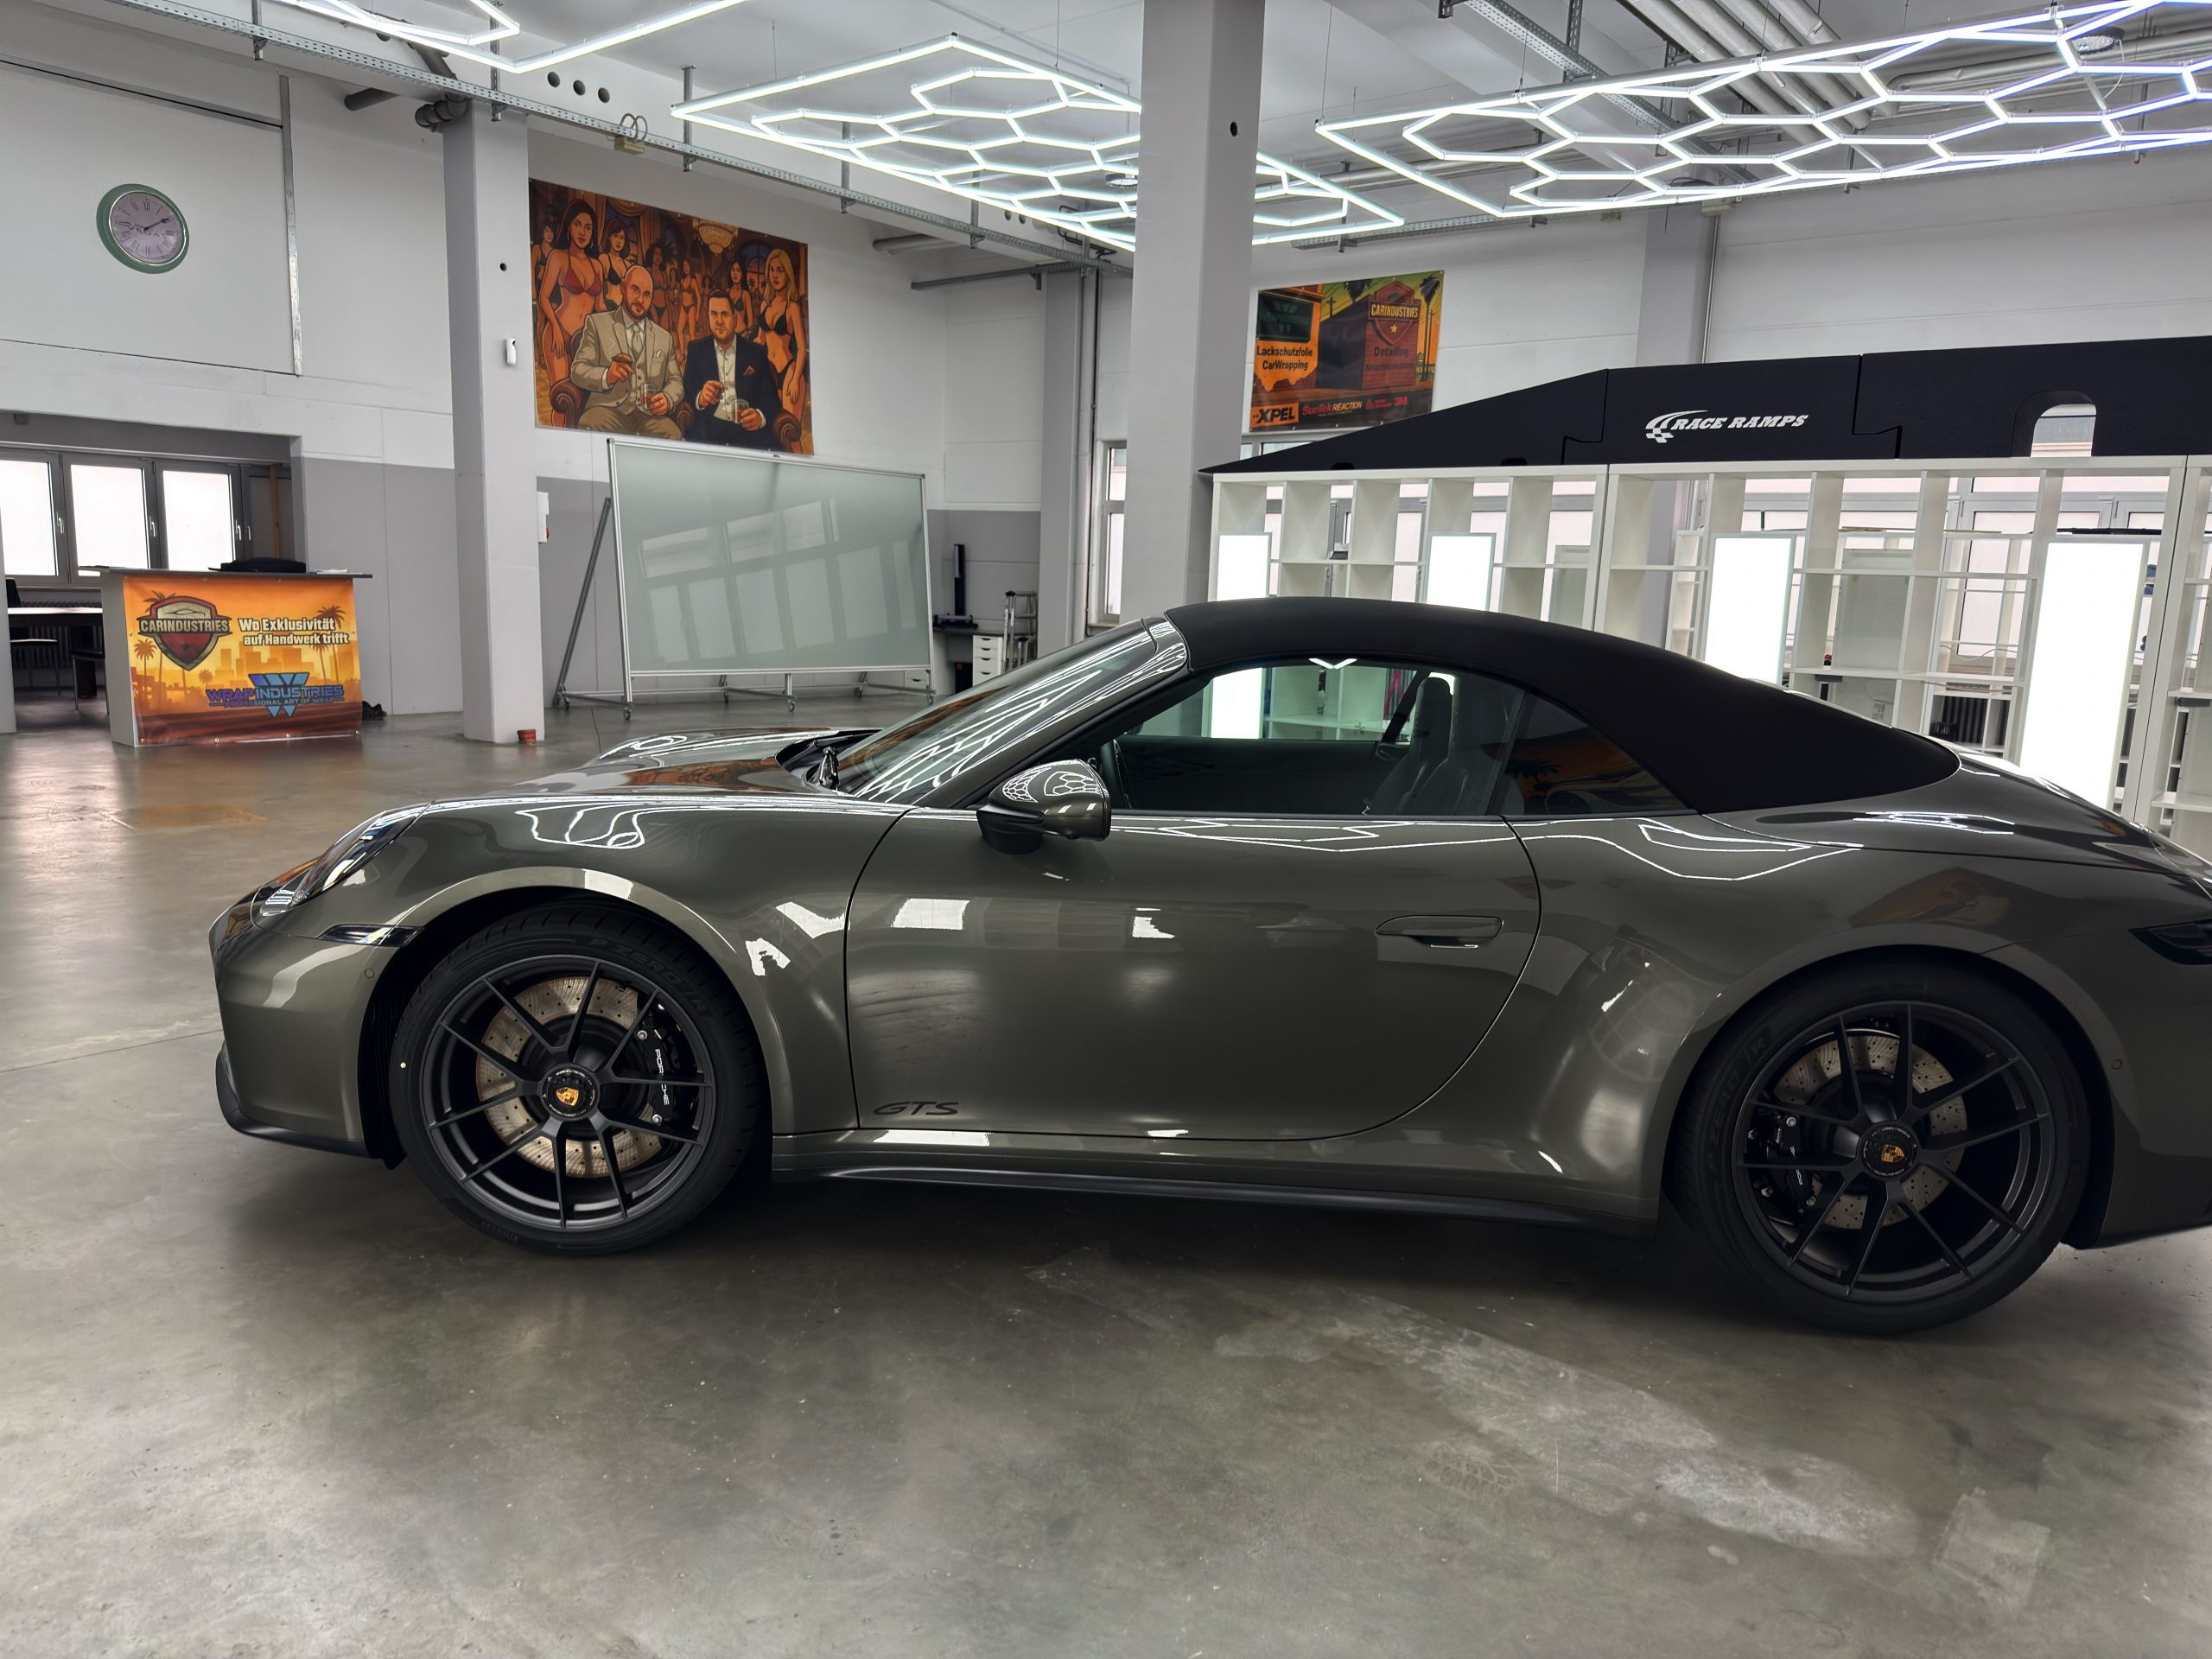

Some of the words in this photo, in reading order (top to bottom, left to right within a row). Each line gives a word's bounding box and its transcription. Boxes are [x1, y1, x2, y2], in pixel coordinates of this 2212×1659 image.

[1371, 304, 1419, 319] CARINDUSTRIES
[1256, 346, 1313, 358] Lackschutzfolie
[1374, 346, 1409, 358] Detailing
[1262, 360, 1308, 372] CarWrapping
[1257, 407, 1295, 423] XPEL
[1301, 404, 1332, 416] SunTek
[1332, 401, 1363, 411] REACTION
[1670, 417, 1728, 430] RACE
[1727, 415, 1809, 429] RAMPS
[140, 619, 229, 633] CARINDUSTRIES
[238, 619, 259, 632] Wo
[262, 617, 334, 632] Exklusivität
[244, 633, 263, 645] auf
[264, 633, 321, 645] Handwerk
[322, 632, 349, 645] trifft
[207, 688, 254, 701] WRAP
[255, 685, 344, 700] INDUSTRIES
[654, 1048, 670, 1106] PORCHE
[873, 1101, 960, 1116] GTS
